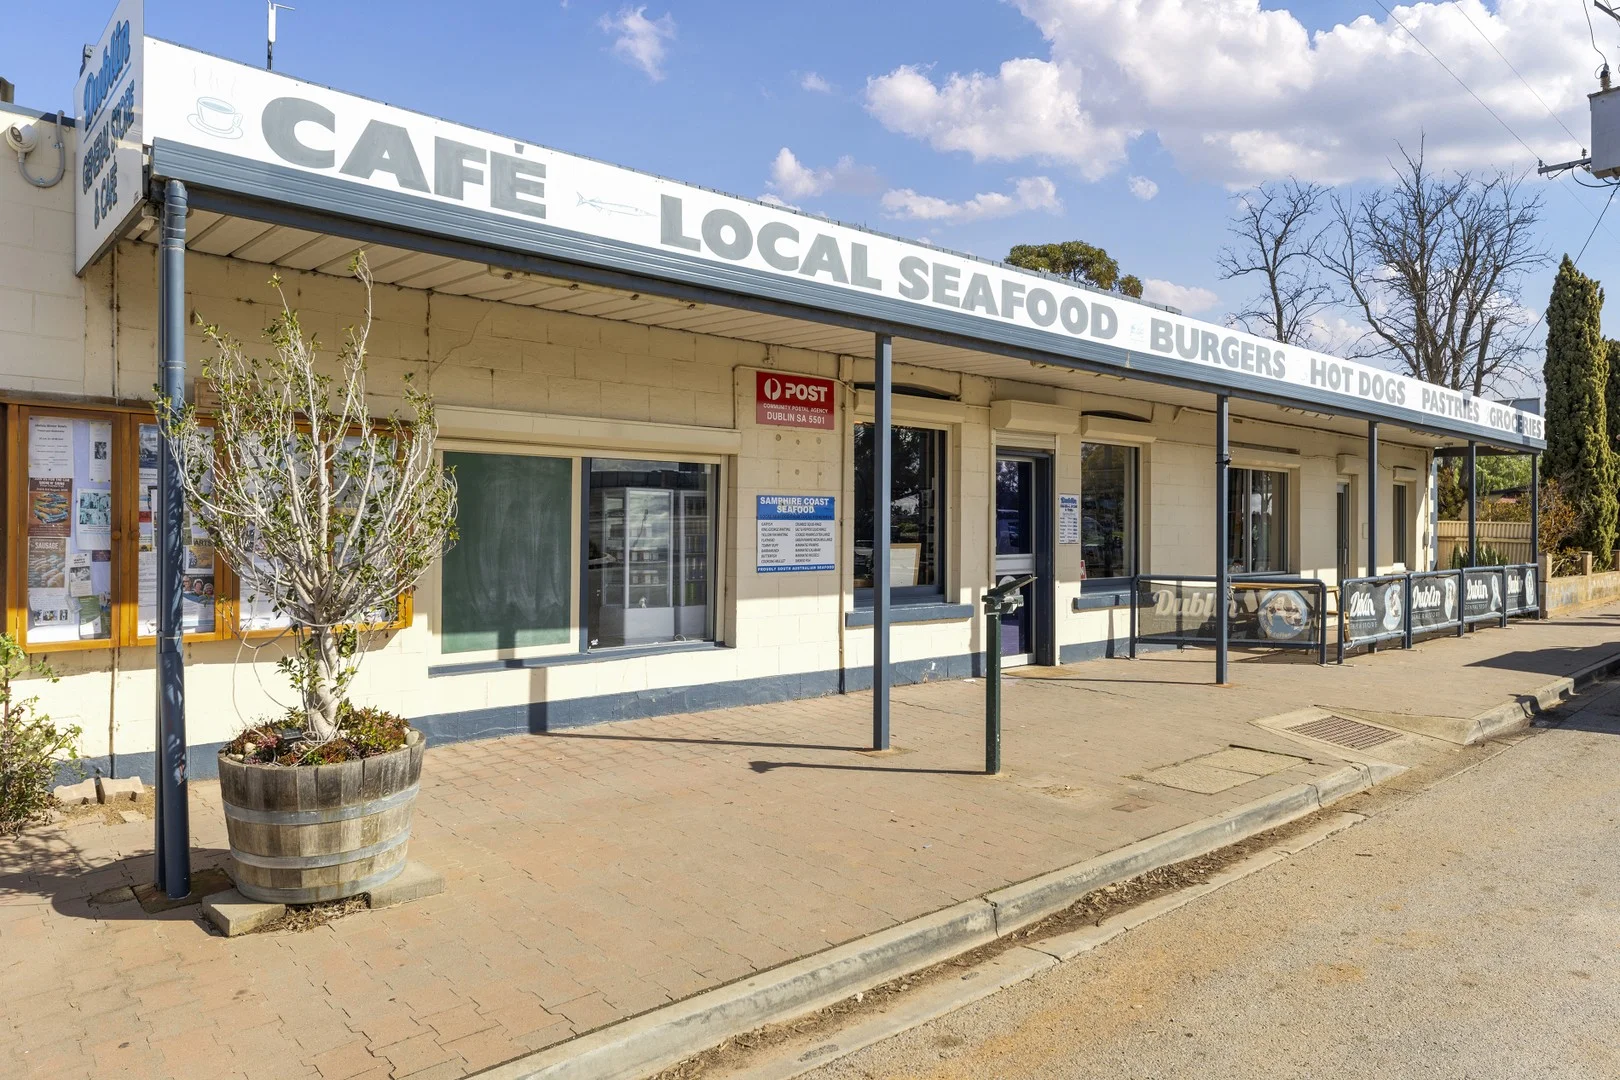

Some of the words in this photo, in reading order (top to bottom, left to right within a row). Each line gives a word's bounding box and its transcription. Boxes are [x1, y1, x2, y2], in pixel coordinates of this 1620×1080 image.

[84, 20, 131, 133] Dublin
[261, 97, 546, 219] CAFÉ
[660, 193, 883, 291] LOCAL
[898, 255, 1118, 340] SEAFOOD
[1150, 317, 1286, 379] BURGERS
[785, 382, 828, 402] POST
[1310, 357, 1354, 393] HOT
[1358, 370, 1406, 405] DOGS
[767, 411, 795, 422] DUBLIN
[796, 414, 807, 423] SA
[808, 415, 825, 424] 5501
[1421, 387, 1480, 422] PASTRIES
[1489, 408, 1542, 440] GROCERIES
[760, 496, 802, 505] SAMPHIRE
[803, 498, 829, 506] COAST
[776, 505, 816, 514] SEAFOOD
